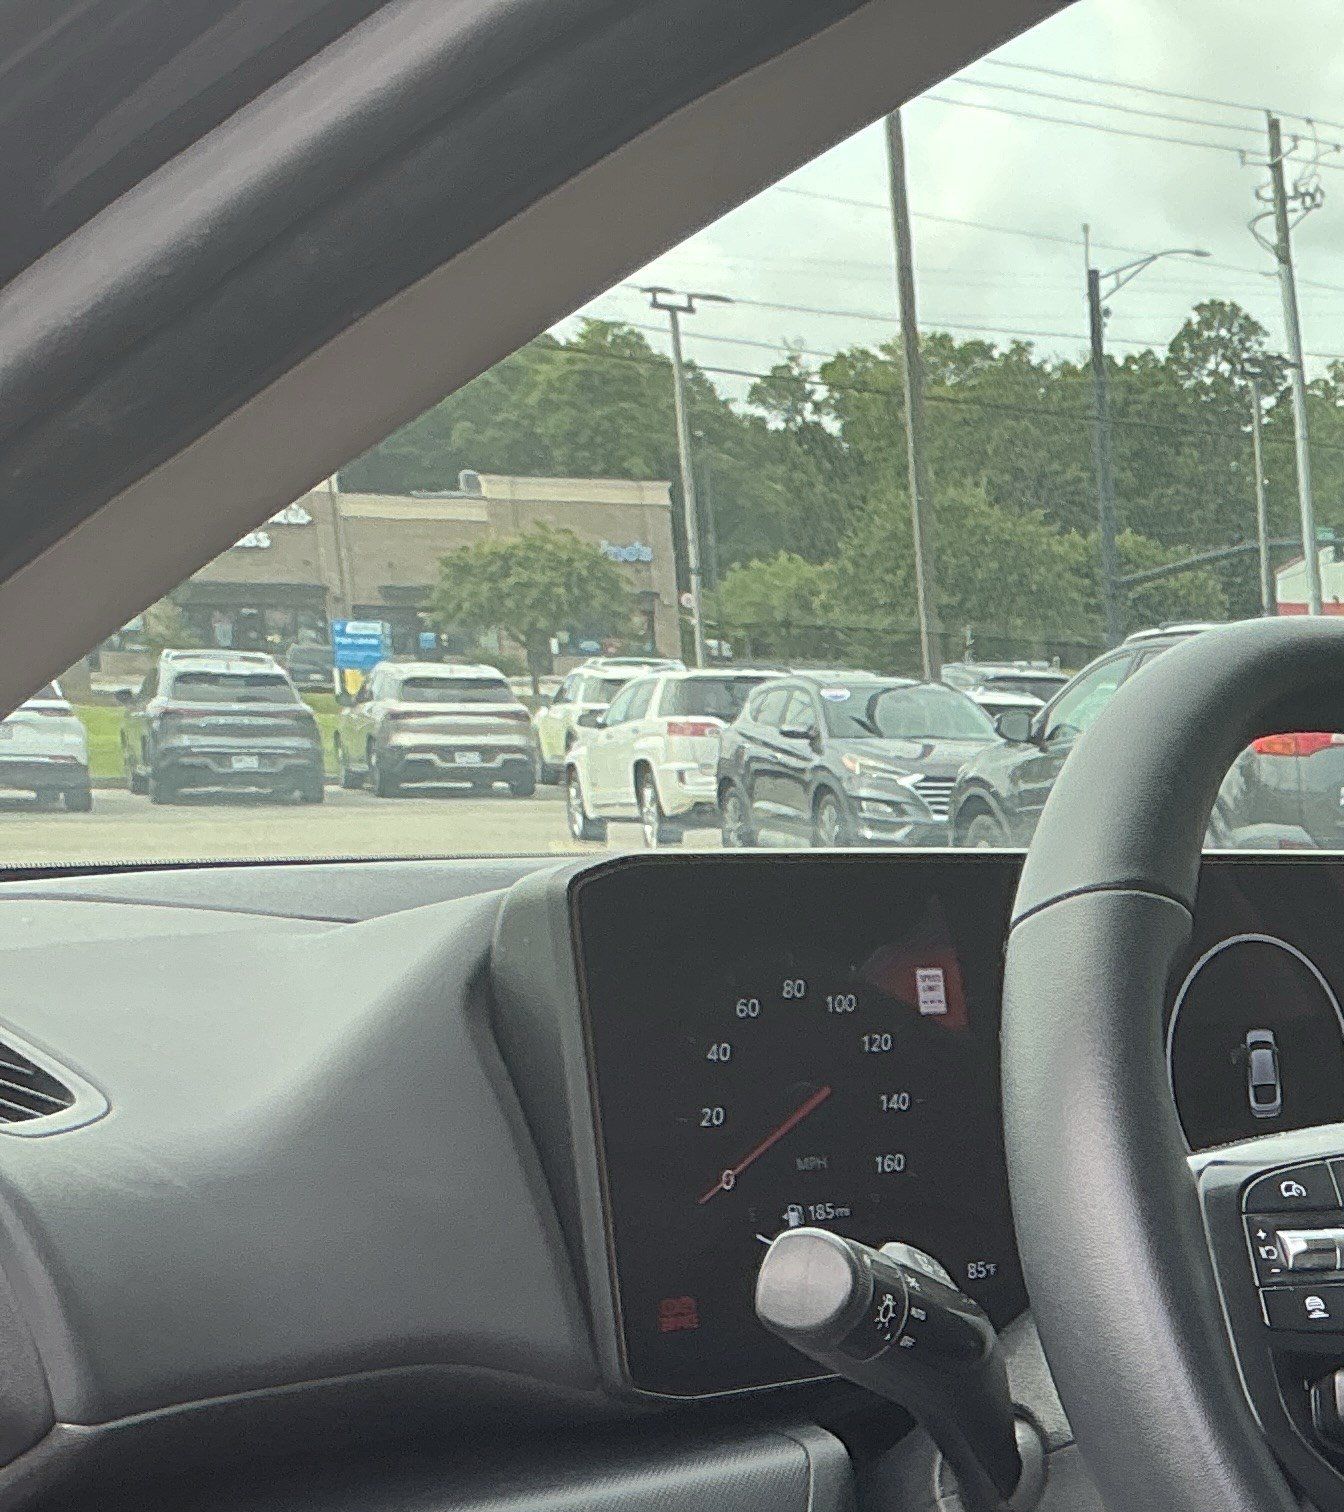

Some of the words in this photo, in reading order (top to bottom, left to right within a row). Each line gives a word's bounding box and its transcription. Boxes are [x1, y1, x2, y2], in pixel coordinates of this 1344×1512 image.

[782, 979, 806, 999] 80
[736, 998, 761, 1018] 60
[826, 994, 858, 1013] 100
[706, 1042, 732, 1062] 40
[861, 1033, 893, 1053] 120
[880, 1092, 910, 1111] 140
[700, 1107, 725, 1127] 20
[875, 1153, 905, 1173] 160
[722, 1169, 735, 1190] 0
